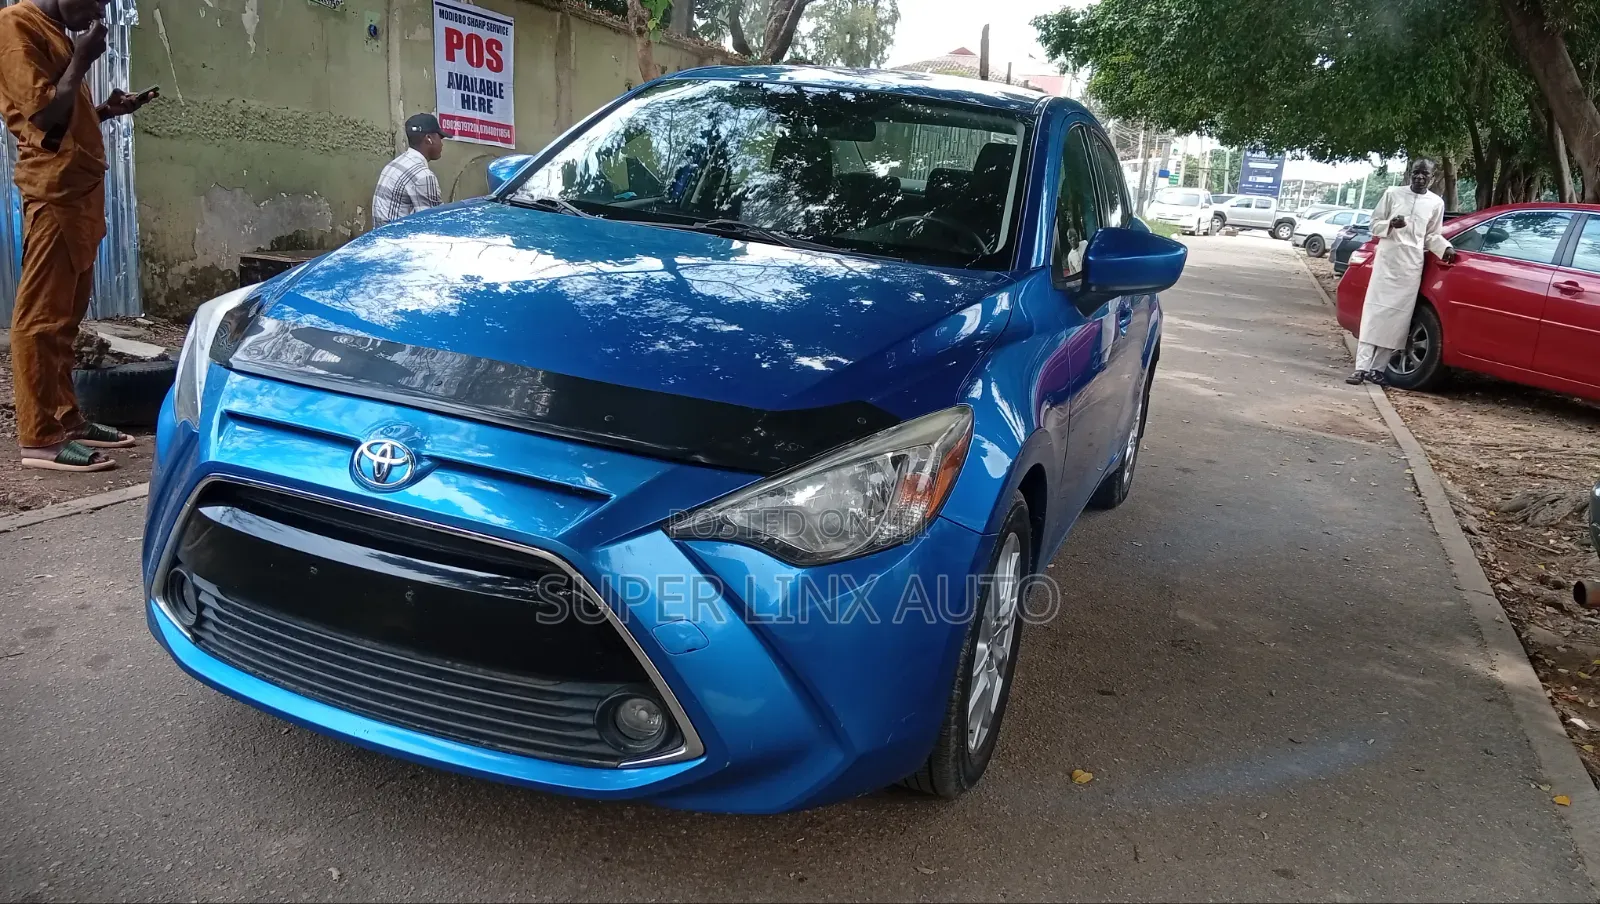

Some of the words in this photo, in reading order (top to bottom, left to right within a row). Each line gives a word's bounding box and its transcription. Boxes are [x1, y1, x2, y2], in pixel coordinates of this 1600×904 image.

[439, 9, 466, 24] MODIBBO
[467, 17, 486, 29] SHARP
[487, 22, 508, 35] SERVICE
[445, 26, 504, 73] POS
[447, 71, 504, 99] AVAILABLE
[461, 93, 493, 114] HERE
